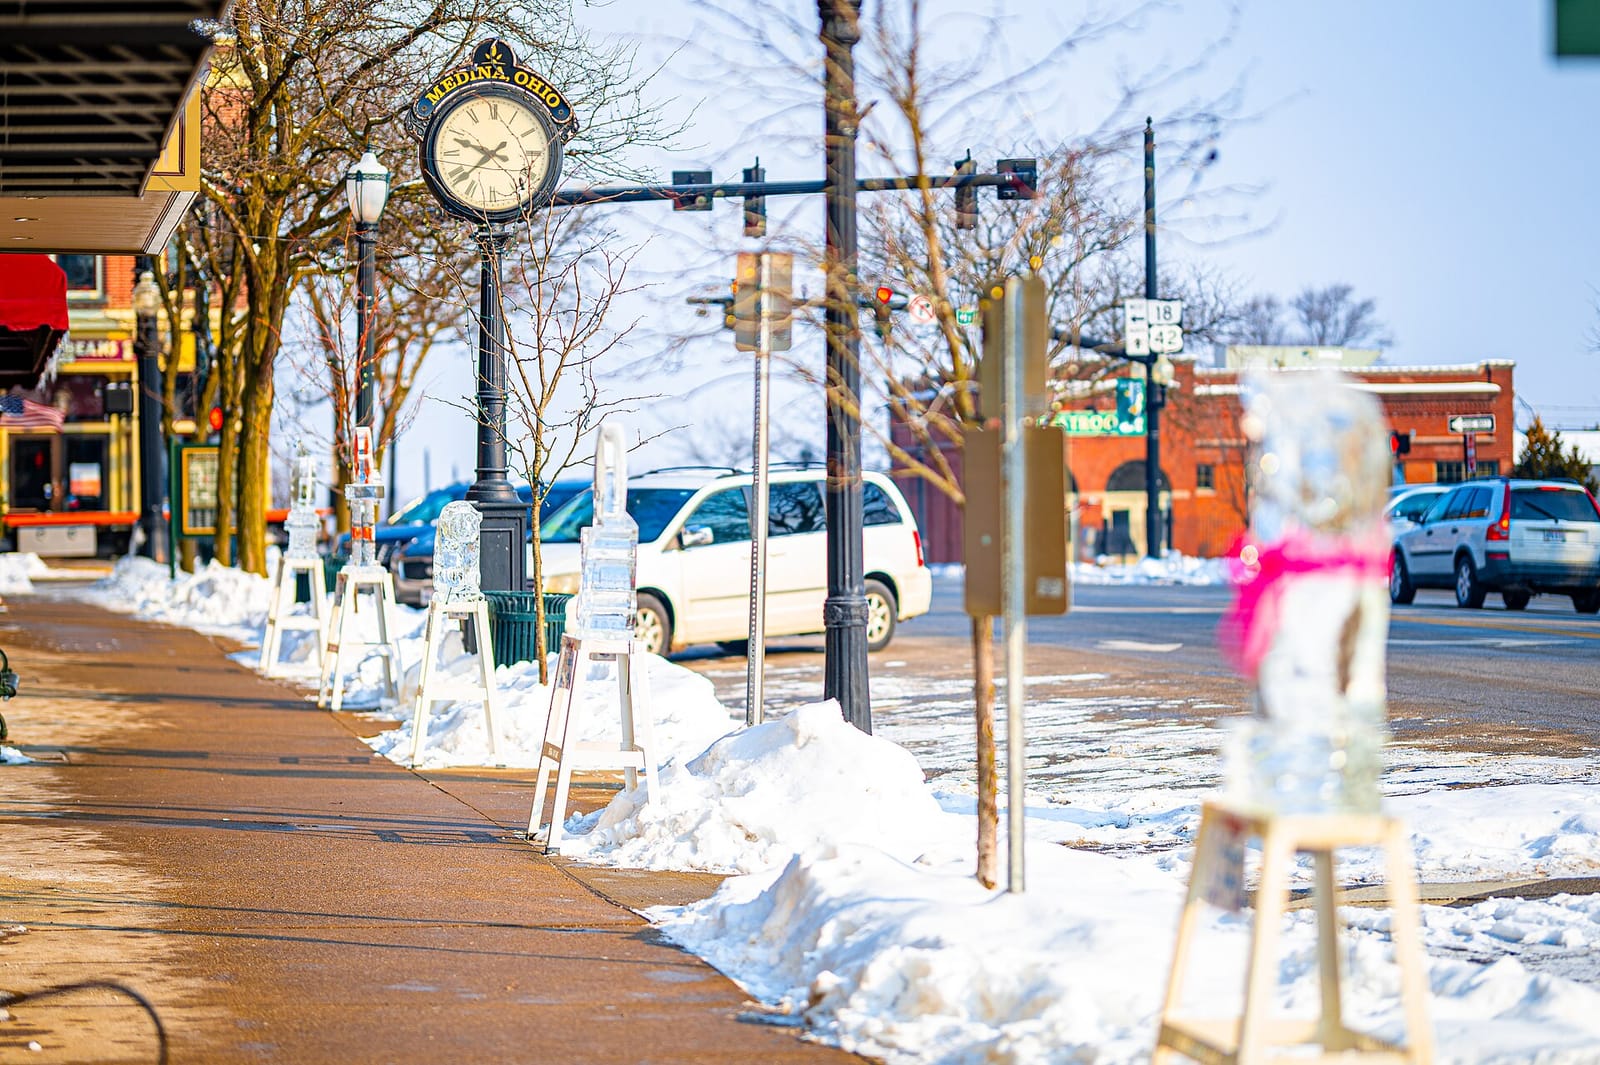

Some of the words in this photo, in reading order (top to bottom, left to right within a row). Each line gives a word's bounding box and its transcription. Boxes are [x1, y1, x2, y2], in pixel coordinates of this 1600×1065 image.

[425, 66, 510, 105] MEDINA,
[514, 71, 561, 108] OHIO
[1157, 305, 1172, 321] 18
[1154, 330, 1177, 345] 42
